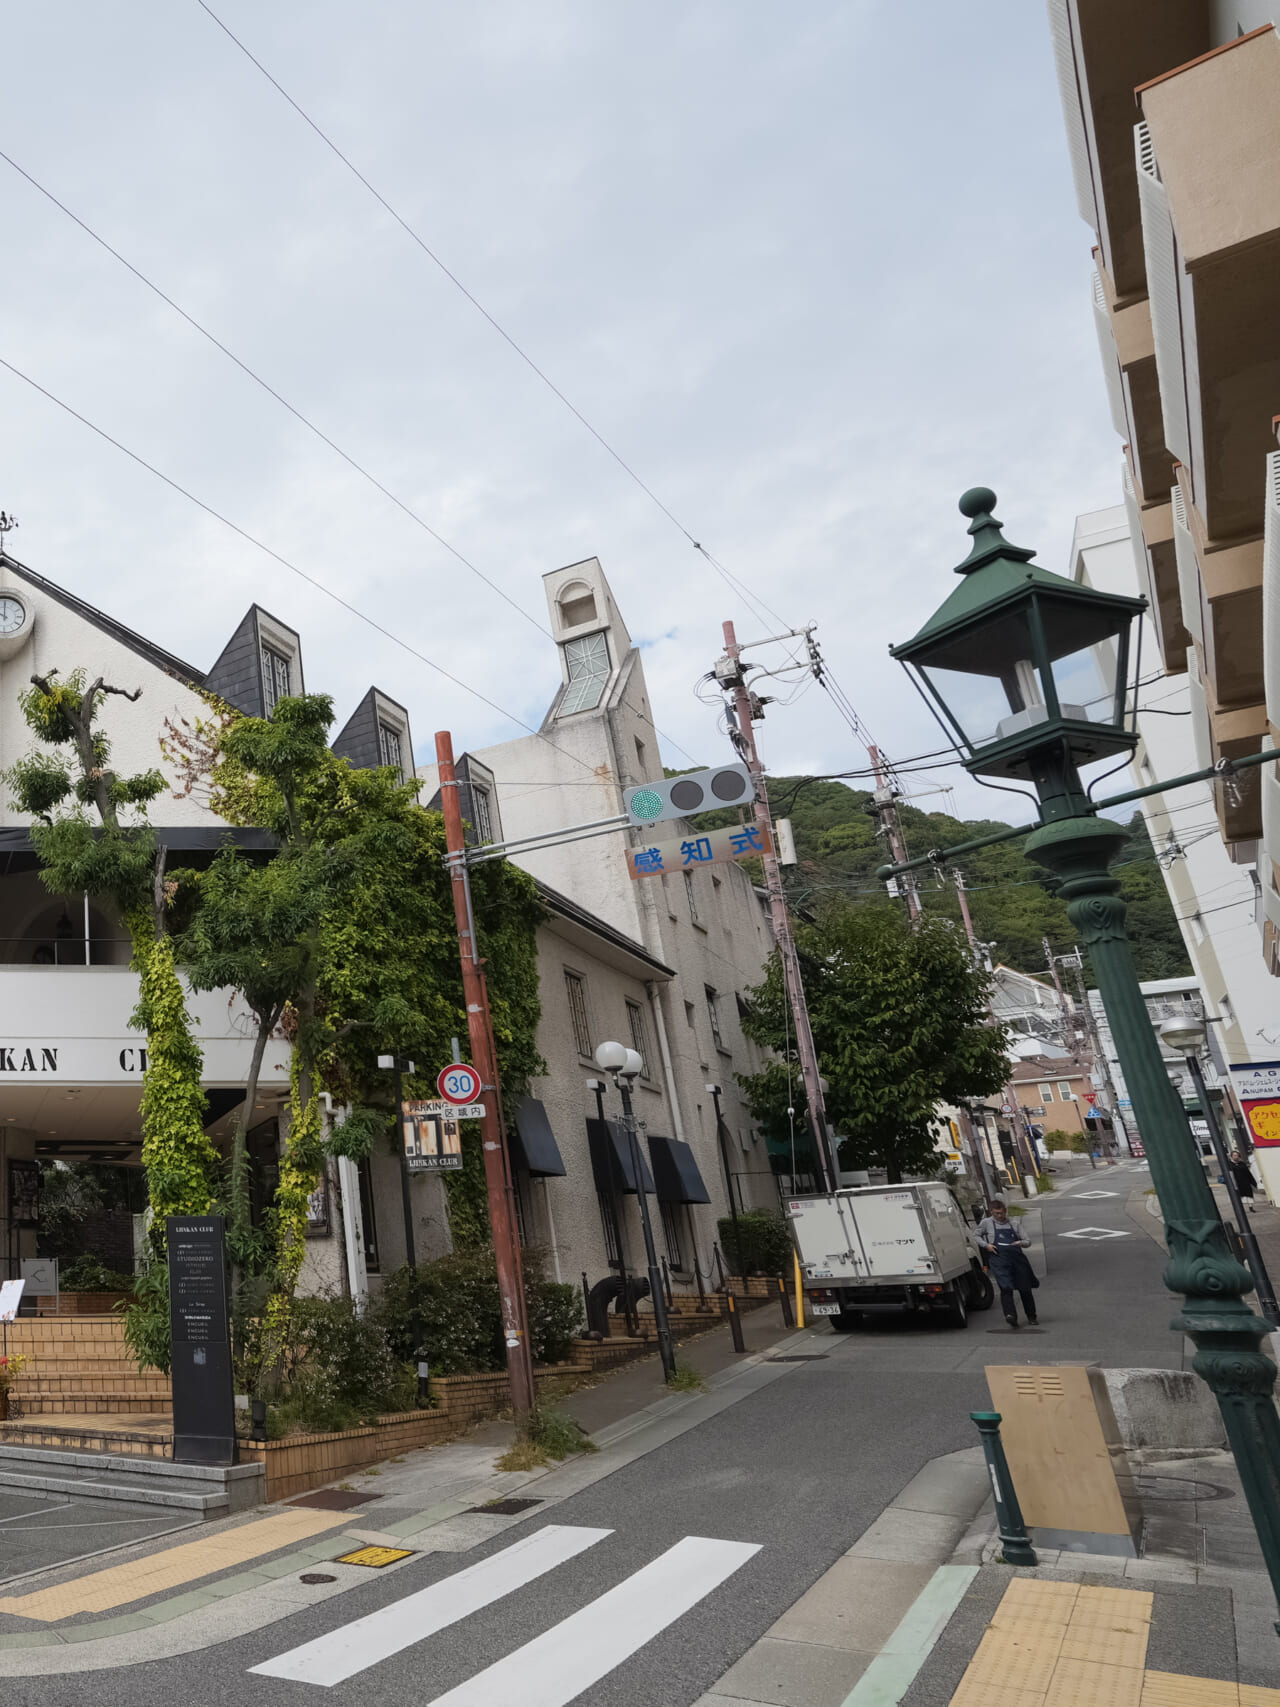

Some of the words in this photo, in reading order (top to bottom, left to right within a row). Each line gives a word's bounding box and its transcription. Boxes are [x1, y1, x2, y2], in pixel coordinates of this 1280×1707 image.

[634, 826, 763, 874] 感知式
[448, 1075, 471, 1094] 30
[444, 1107, 481, 1118] 区域内
